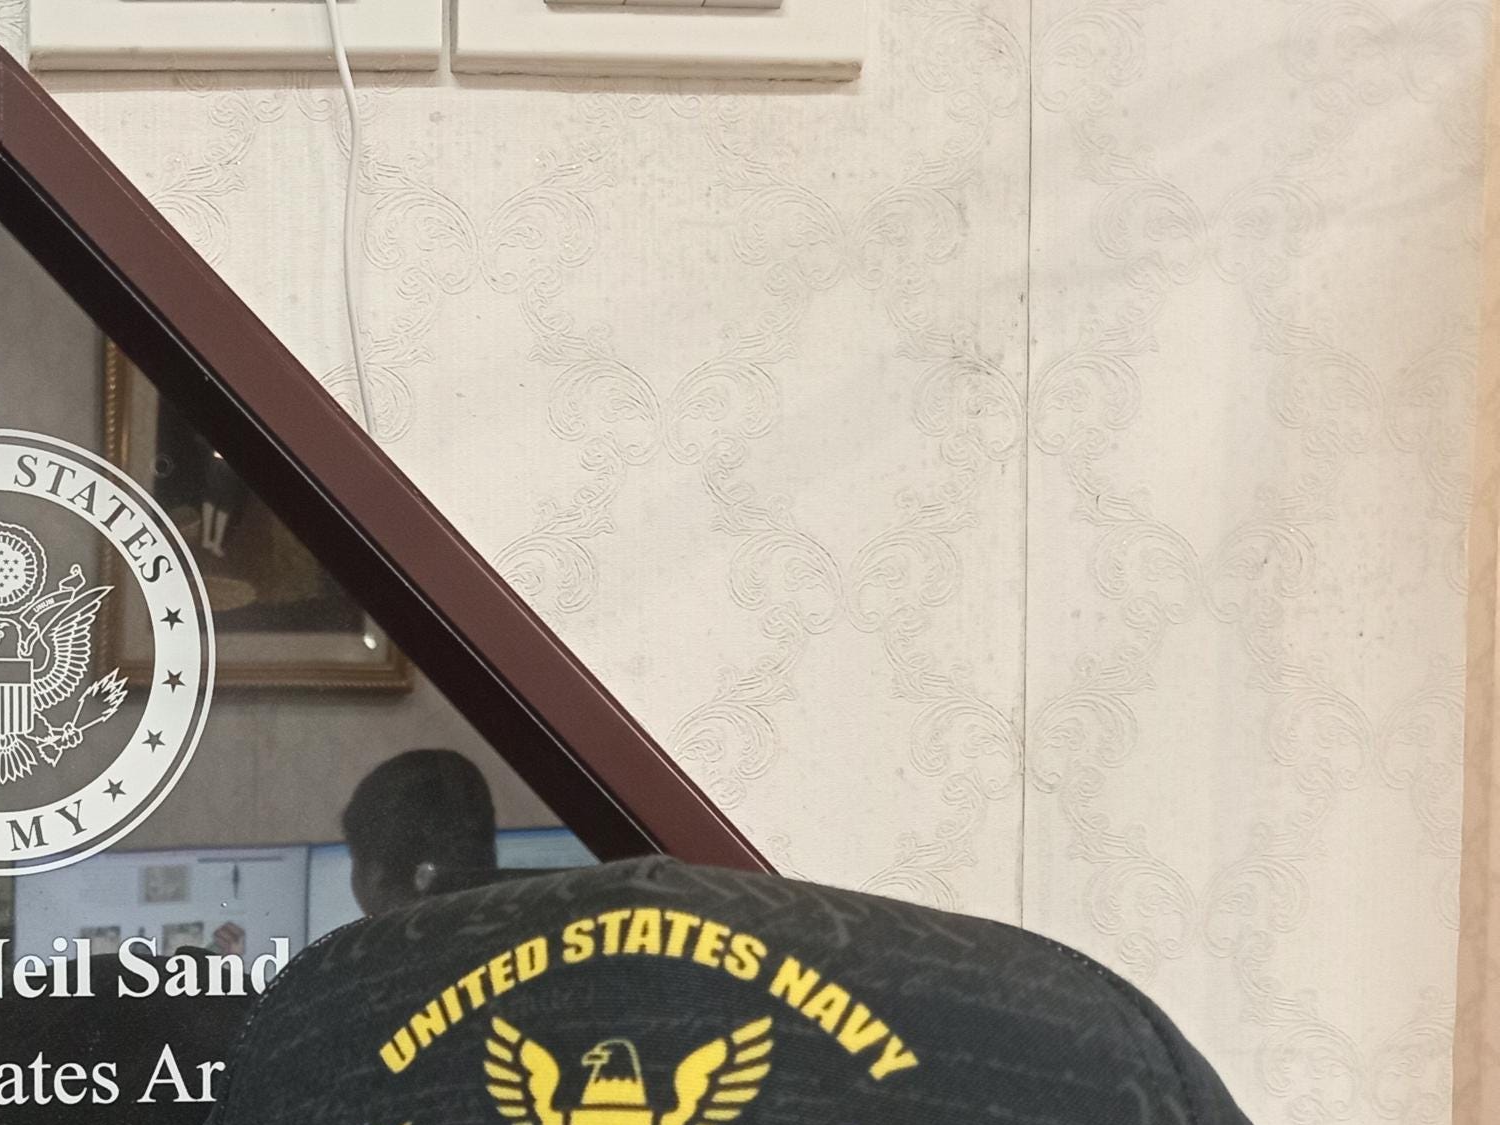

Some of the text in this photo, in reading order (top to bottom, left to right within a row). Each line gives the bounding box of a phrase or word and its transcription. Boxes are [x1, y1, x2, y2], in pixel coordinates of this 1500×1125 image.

[14, 454, 173, 584] STATES
[118, 936, 289, 998] Sand
[379, 935, 550, 1074] UNITED
[562, 906, 768, 980] STATES
[769, 956, 918, 1080] NAVY
[137, 1043, 226, 1103] Ar
